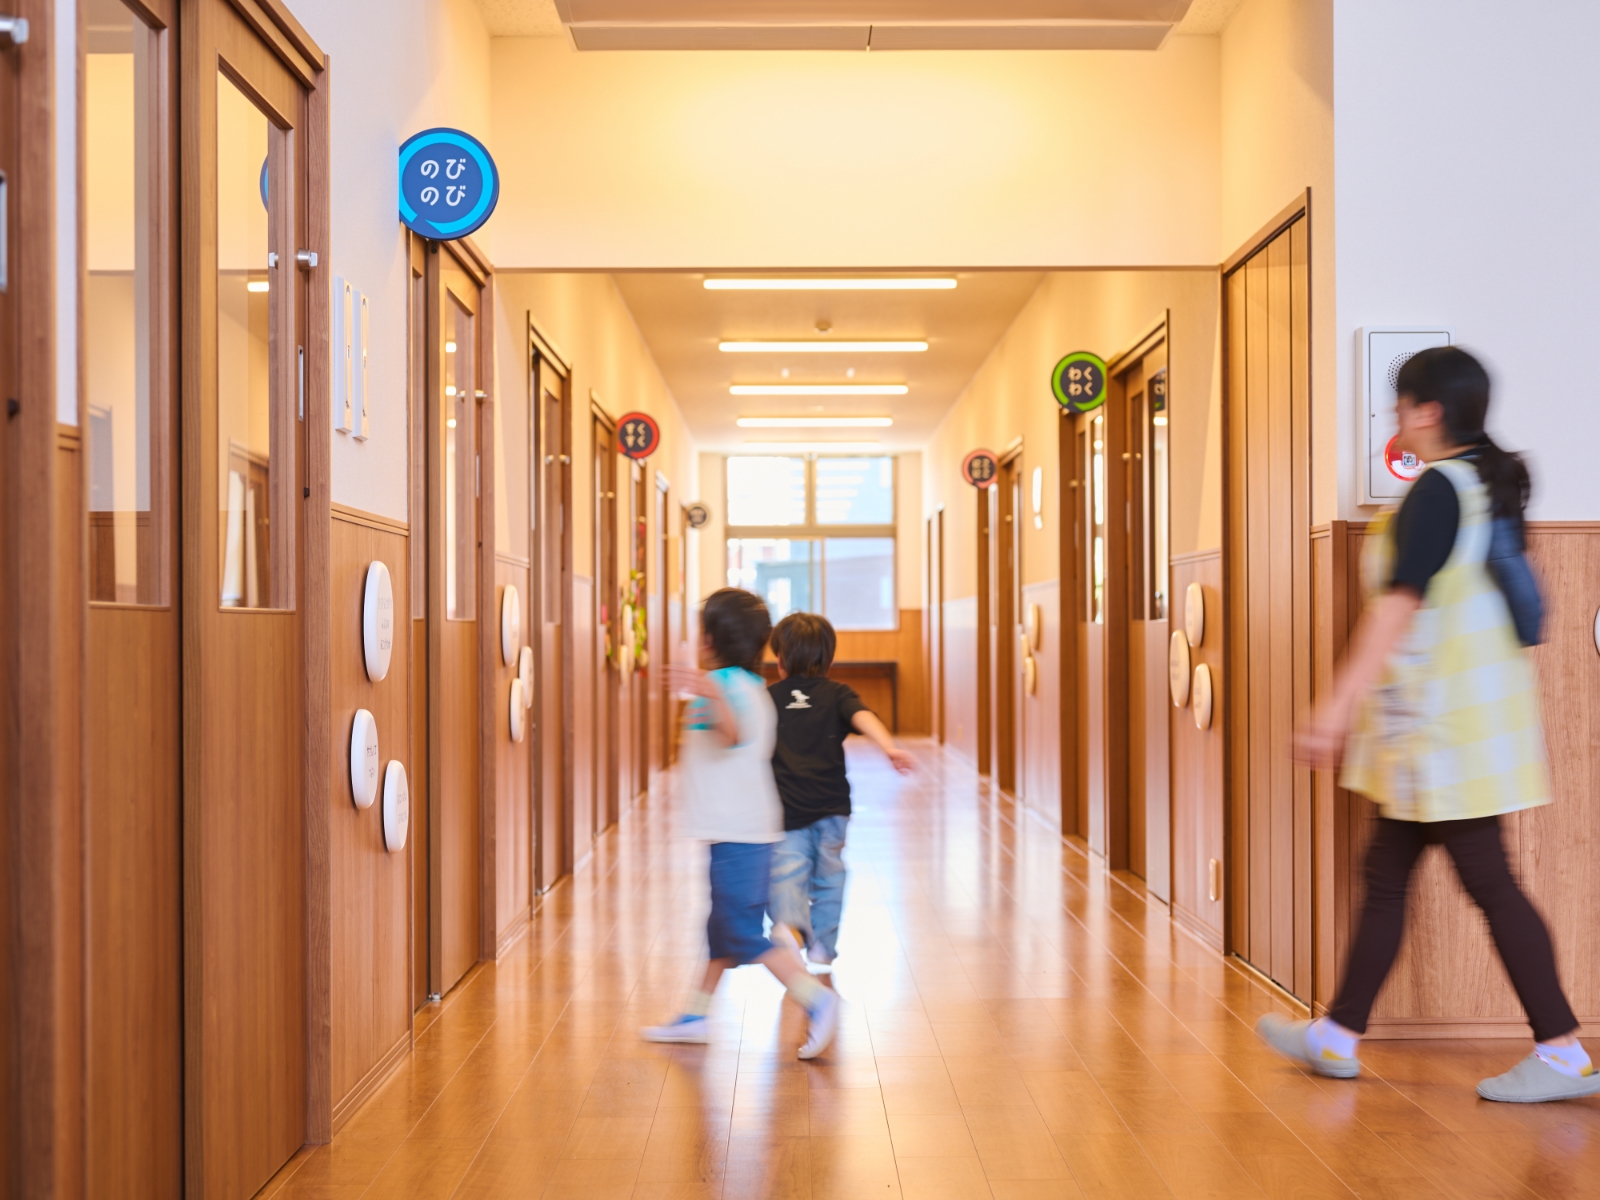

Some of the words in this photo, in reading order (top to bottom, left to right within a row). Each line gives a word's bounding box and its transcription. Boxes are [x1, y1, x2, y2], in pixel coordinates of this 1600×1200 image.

[420, 158, 466, 179] のび
[420, 185, 466, 207] のび
[1067, 366, 1093, 381] わく
[1068, 381, 1094, 397] わく
